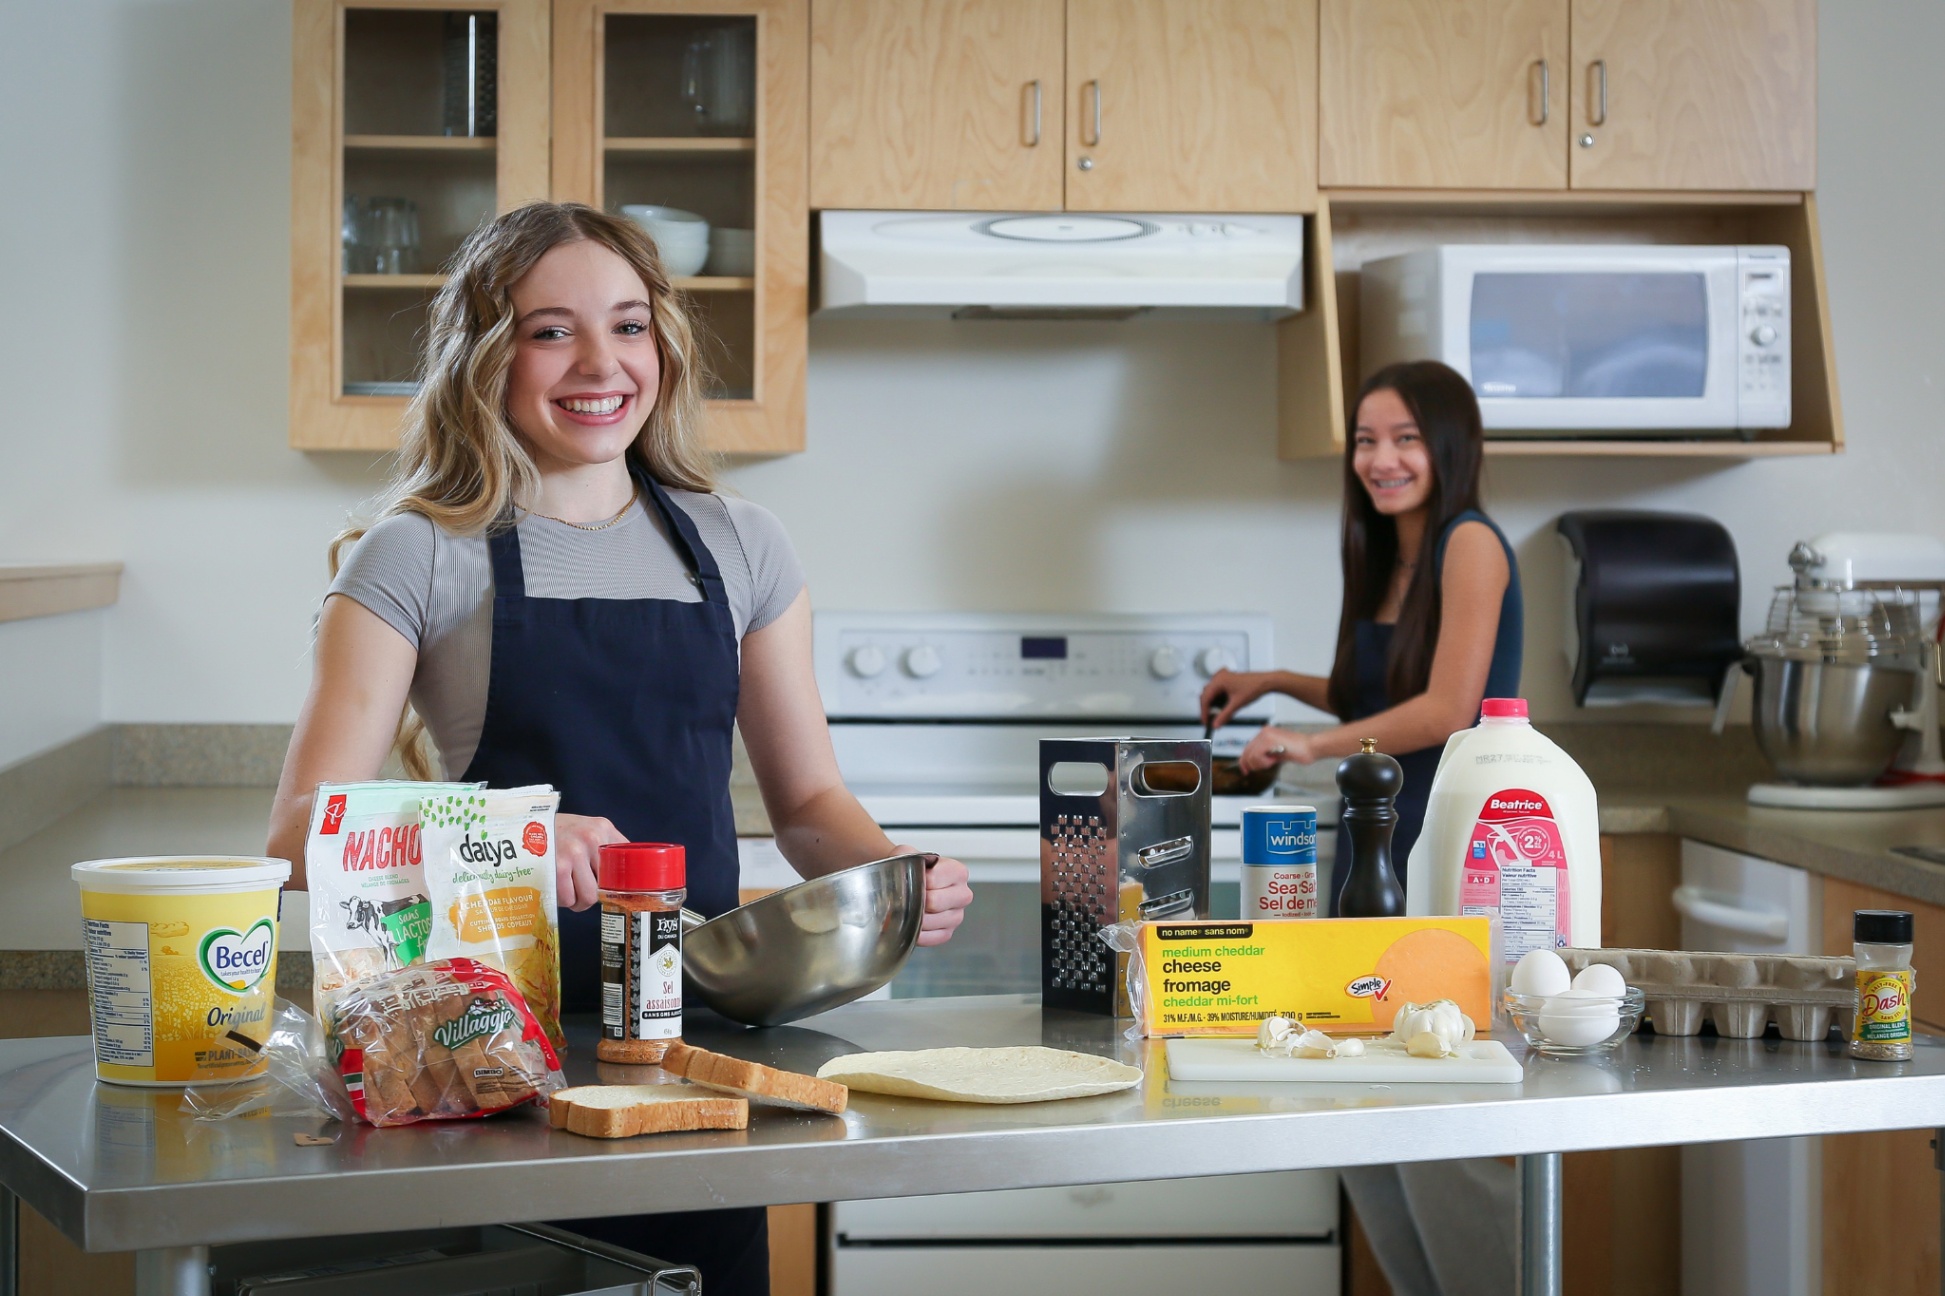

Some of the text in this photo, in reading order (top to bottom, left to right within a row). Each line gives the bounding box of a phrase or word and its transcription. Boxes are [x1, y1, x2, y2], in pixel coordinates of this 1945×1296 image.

[1490, 799, 1542, 810] Beatrice
[459, 833, 517, 867] daiya
[1548, 850, 1564, 859] 4 L
[1273, 872, 1301, 880] Coarse
[1268, 881, 1298, 895] Sea
[1259, 896, 1283, 910] Sel
[1286, 895, 1305, 910] de
[398, 909, 420, 925] sans
[1161, 927, 1245, 937] no name sans nom
[216, 941, 266, 969] Becel
[1162, 945, 1266, 958] medium cheddar
[1162, 959, 1222, 973] cheese
[663, 980, 674, 995] Sel
[1163, 979, 1231, 995] fromage
[1350, 977, 1382, 994] Simple
[1163, 995, 1258, 1007] cheddar mi-fort
[1862, 986, 1906, 1017] Dash
[207, 1002, 266, 1030] Original
[1163, 1014, 1176, 1023] 31%
[1207, 1012, 1220, 1022] 39%
[1297, 1012, 1303, 1021] g
[434, 1006, 515, 1045] Villaggio
[1891, 1021, 1906, 1029] BLEND
